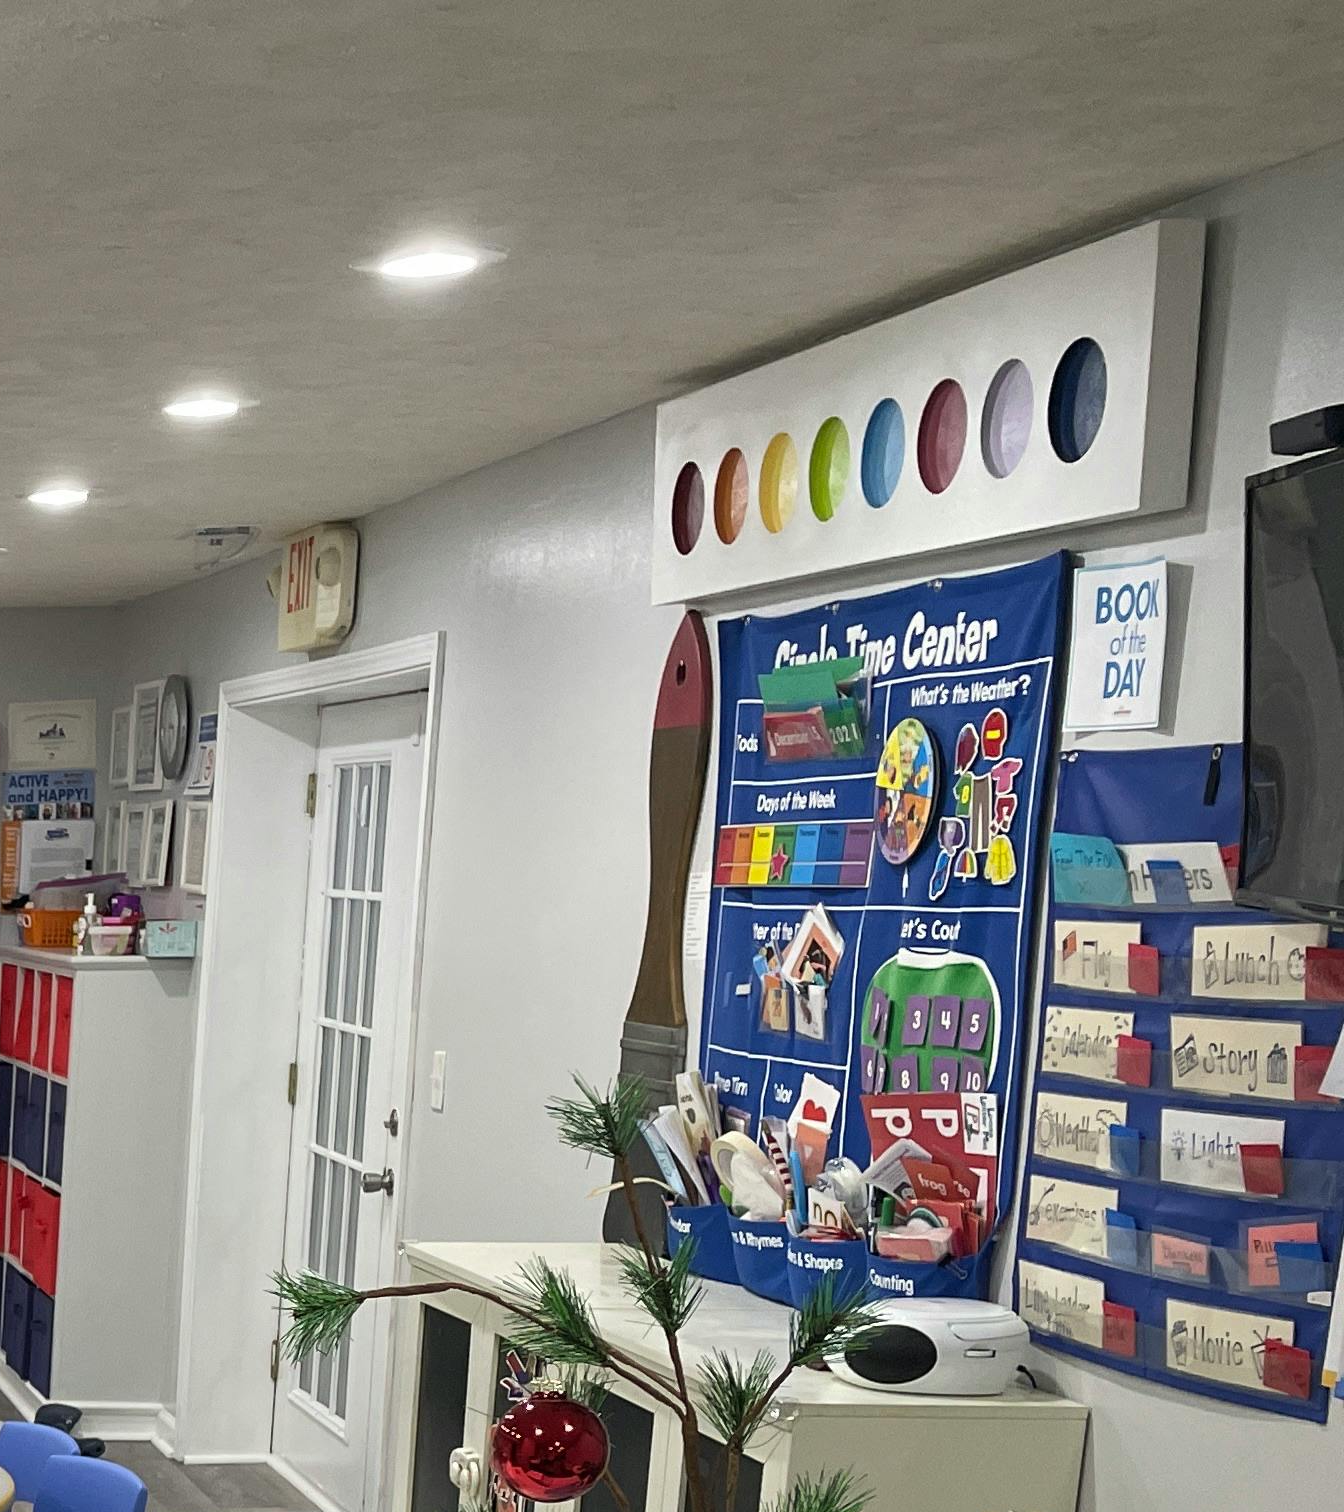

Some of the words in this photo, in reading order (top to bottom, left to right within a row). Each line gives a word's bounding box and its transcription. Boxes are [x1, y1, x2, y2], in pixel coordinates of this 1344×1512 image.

[1096, 578, 1160, 624] BOOK
[846, 623, 896, 677] Time
[902, 610, 999, 669] Center
[1110, 624, 1128, 656] of
[1129, 624, 1147, 655] the
[1103, 658, 1146, 699] DAY
[911, 683, 949, 707] What's
[9, 774, 50, 788] ACTIVE
[8, 788, 34, 803] and
[38, 788, 89, 802] HAPPY!
[757, 794, 779, 816] Days
[780, 793, 792, 811] of
[792, 792, 808, 810] the
[809, 792, 836, 810] Week
[1223, 936, 1281, 986] Lunch
[912, 1009, 922, 1030] 3
[939, 1009, 951, 1029] 4
[970, 1013, 980, 1034] 5
[866, 1060, 873, 1078] 6
[900, 1069, 910, 1090] 8
[940, 1072, 949, 1091] 9
[966, 1070, 981, 1092] 10
[1202, 1040, 1259, 1091] Story
[917, 1173, 948, 1196] frog
[746, 1232, 784, 1250] Rhymes
[804, 1252, 844, 1271] Shapes
[870, 1268, 914, 1296] Counting
[1193, 1325, 1244, 1367] Movie
